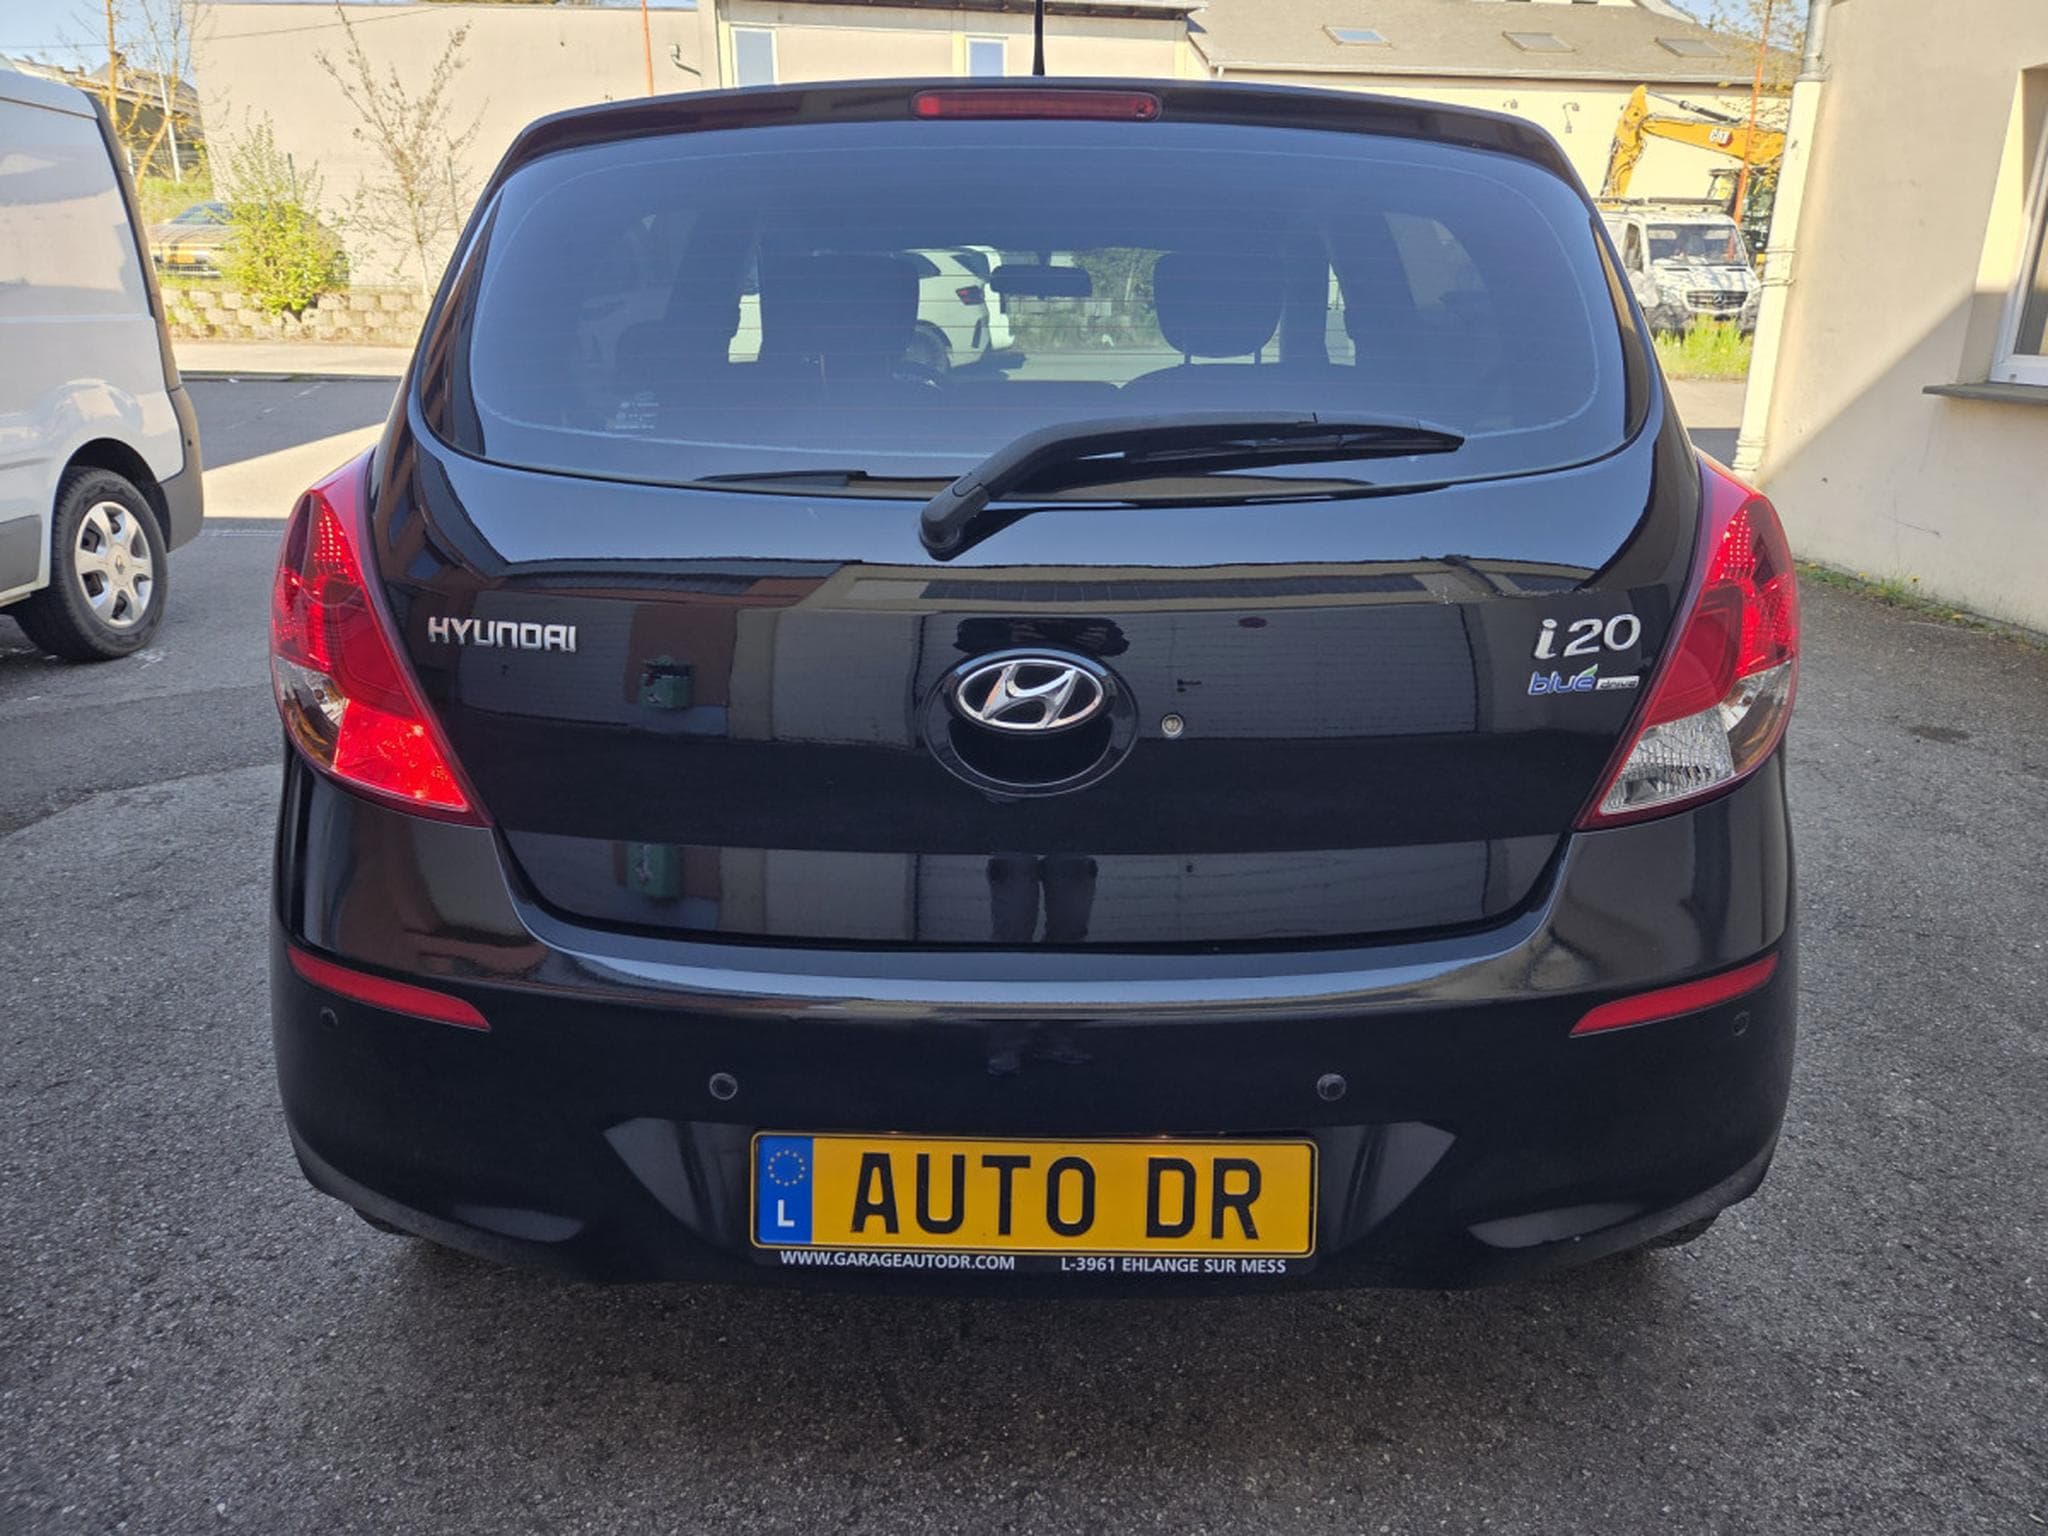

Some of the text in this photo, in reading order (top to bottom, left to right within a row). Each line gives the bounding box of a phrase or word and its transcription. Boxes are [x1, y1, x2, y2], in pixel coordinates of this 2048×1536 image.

[428, 616, 577, 652] HYUNDAI
[1528, 668, 1597, 695] blue
[850, 1152, 1260, 1240] AUTO DR
[777, 1199, 795, 1227] L
[780, 1250, 1016, 1271] WWW.GARAGEAUTODR.COM
[1060, 1256, 1287, 1274] L-3961 EHLANGE SUR MESS
